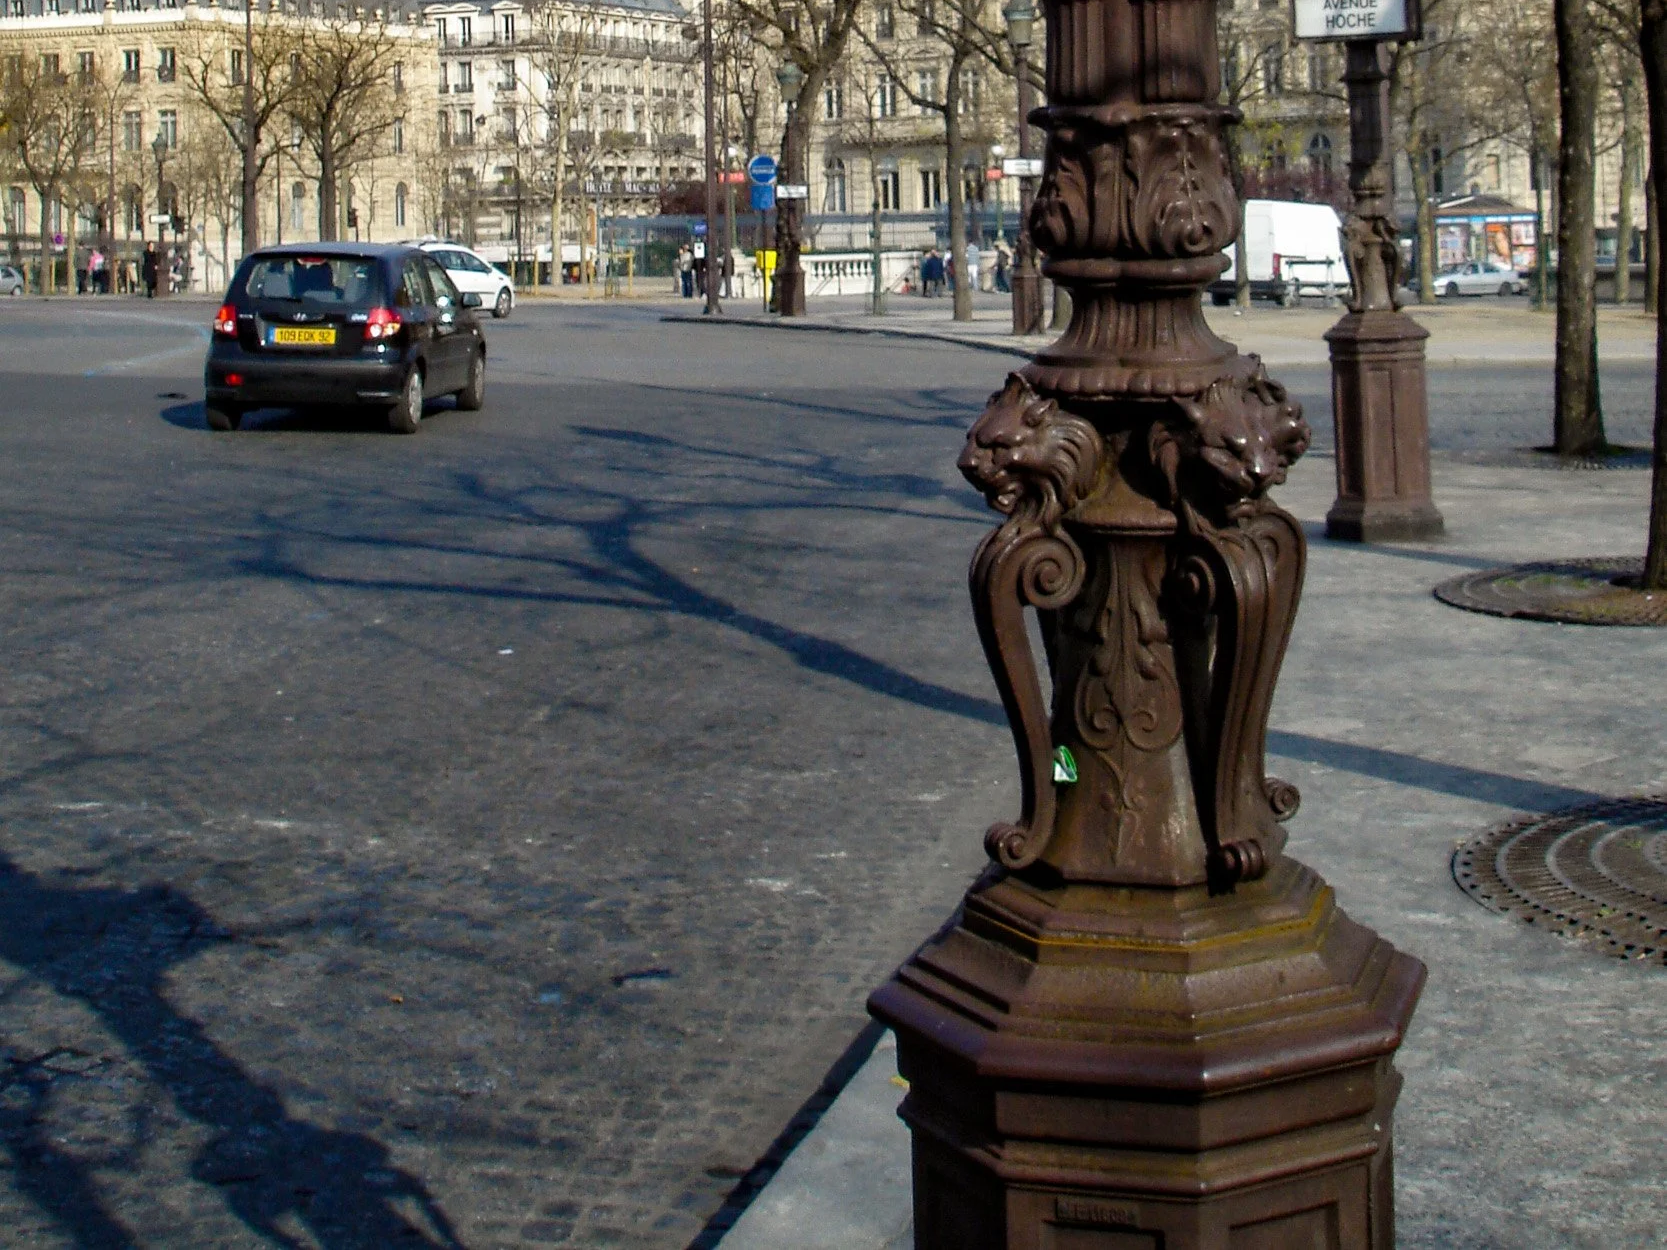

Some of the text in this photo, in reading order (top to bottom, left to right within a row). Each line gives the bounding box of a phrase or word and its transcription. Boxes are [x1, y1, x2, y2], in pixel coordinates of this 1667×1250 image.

[1325, 13, 1376, 29] HOCHE
[279, 330, 296, 342] 109
[318, 332, 331, 343] 92
